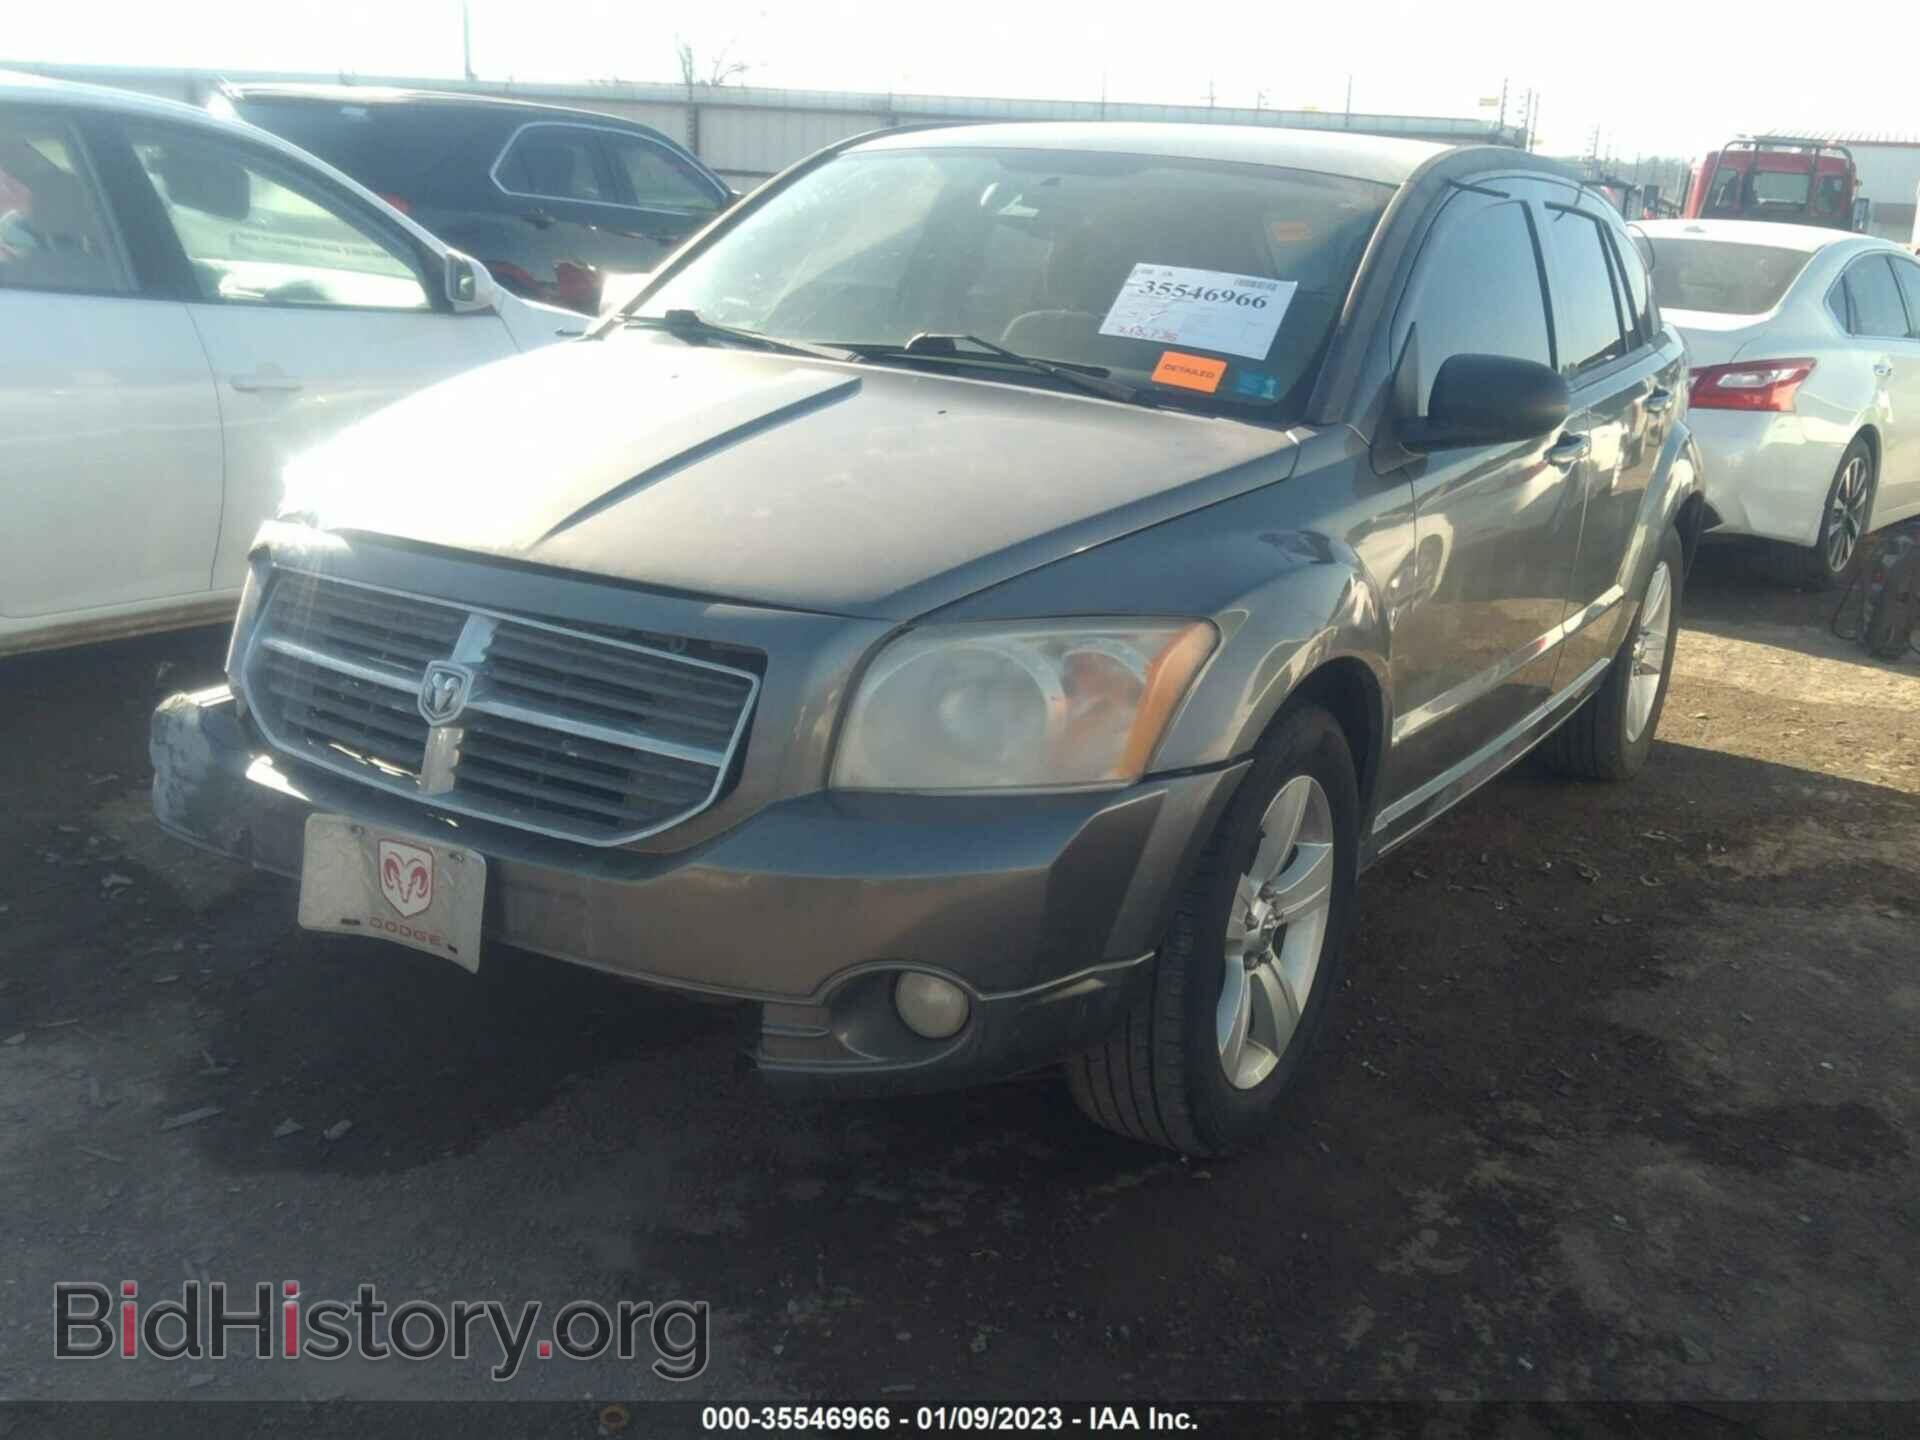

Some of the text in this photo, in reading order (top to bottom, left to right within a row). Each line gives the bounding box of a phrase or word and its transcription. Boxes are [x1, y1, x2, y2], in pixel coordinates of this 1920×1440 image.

[1139, 280, 1267, 309] 35546966
[1164, 364, 1215, 378] DETAILED
[369, 916, 442, 945] DODGE
